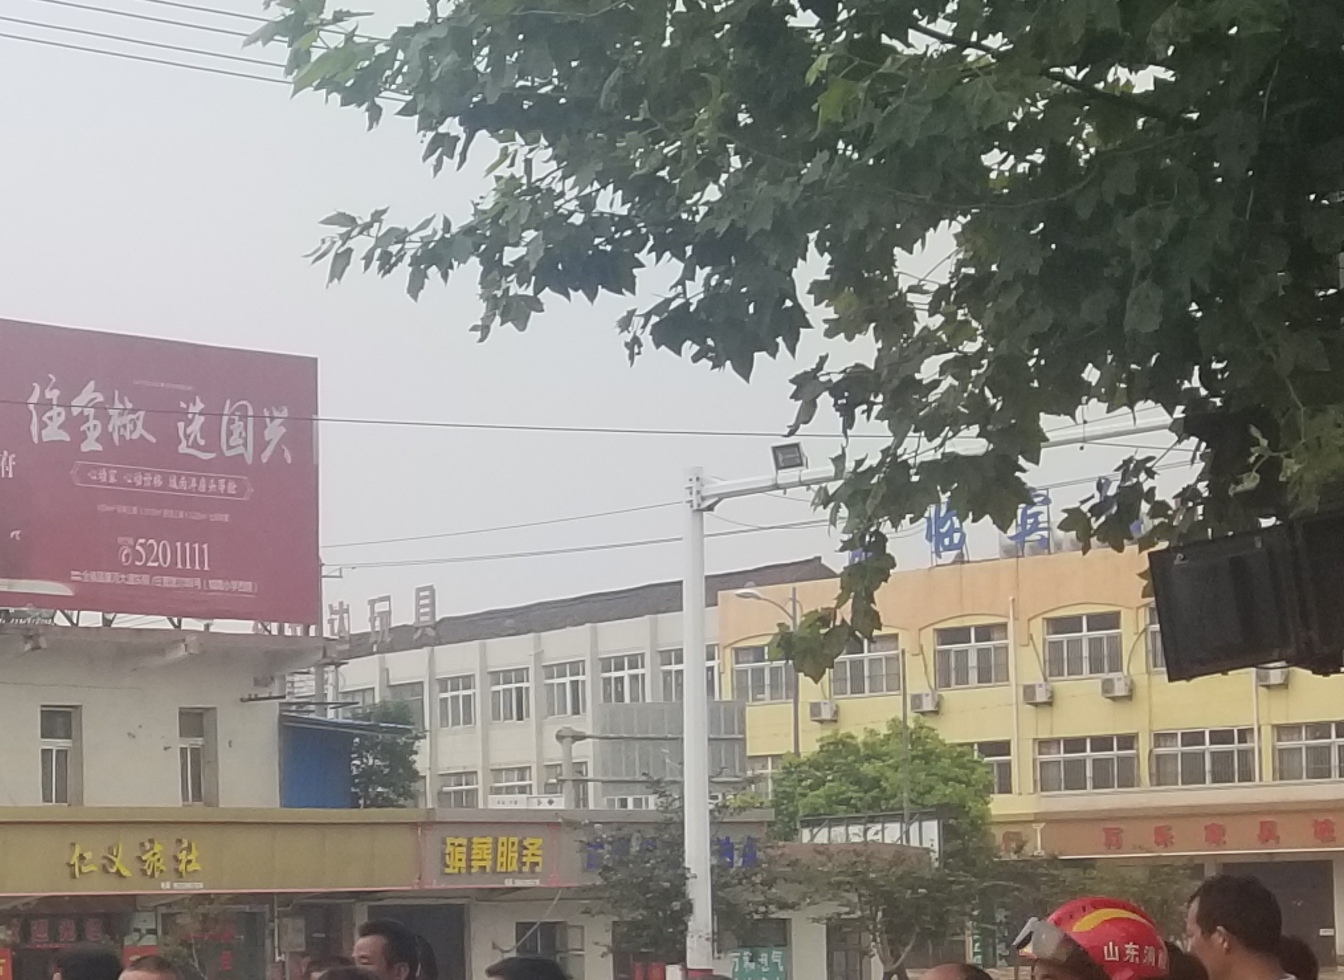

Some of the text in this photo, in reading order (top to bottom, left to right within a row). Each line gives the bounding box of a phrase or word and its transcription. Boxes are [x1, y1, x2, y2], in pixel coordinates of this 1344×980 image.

[177, 396, 291, 465] 选国兴
[68, 837, 202, 879] 仁义旅社
[444, 836, 544, 875] 殡葬服务
